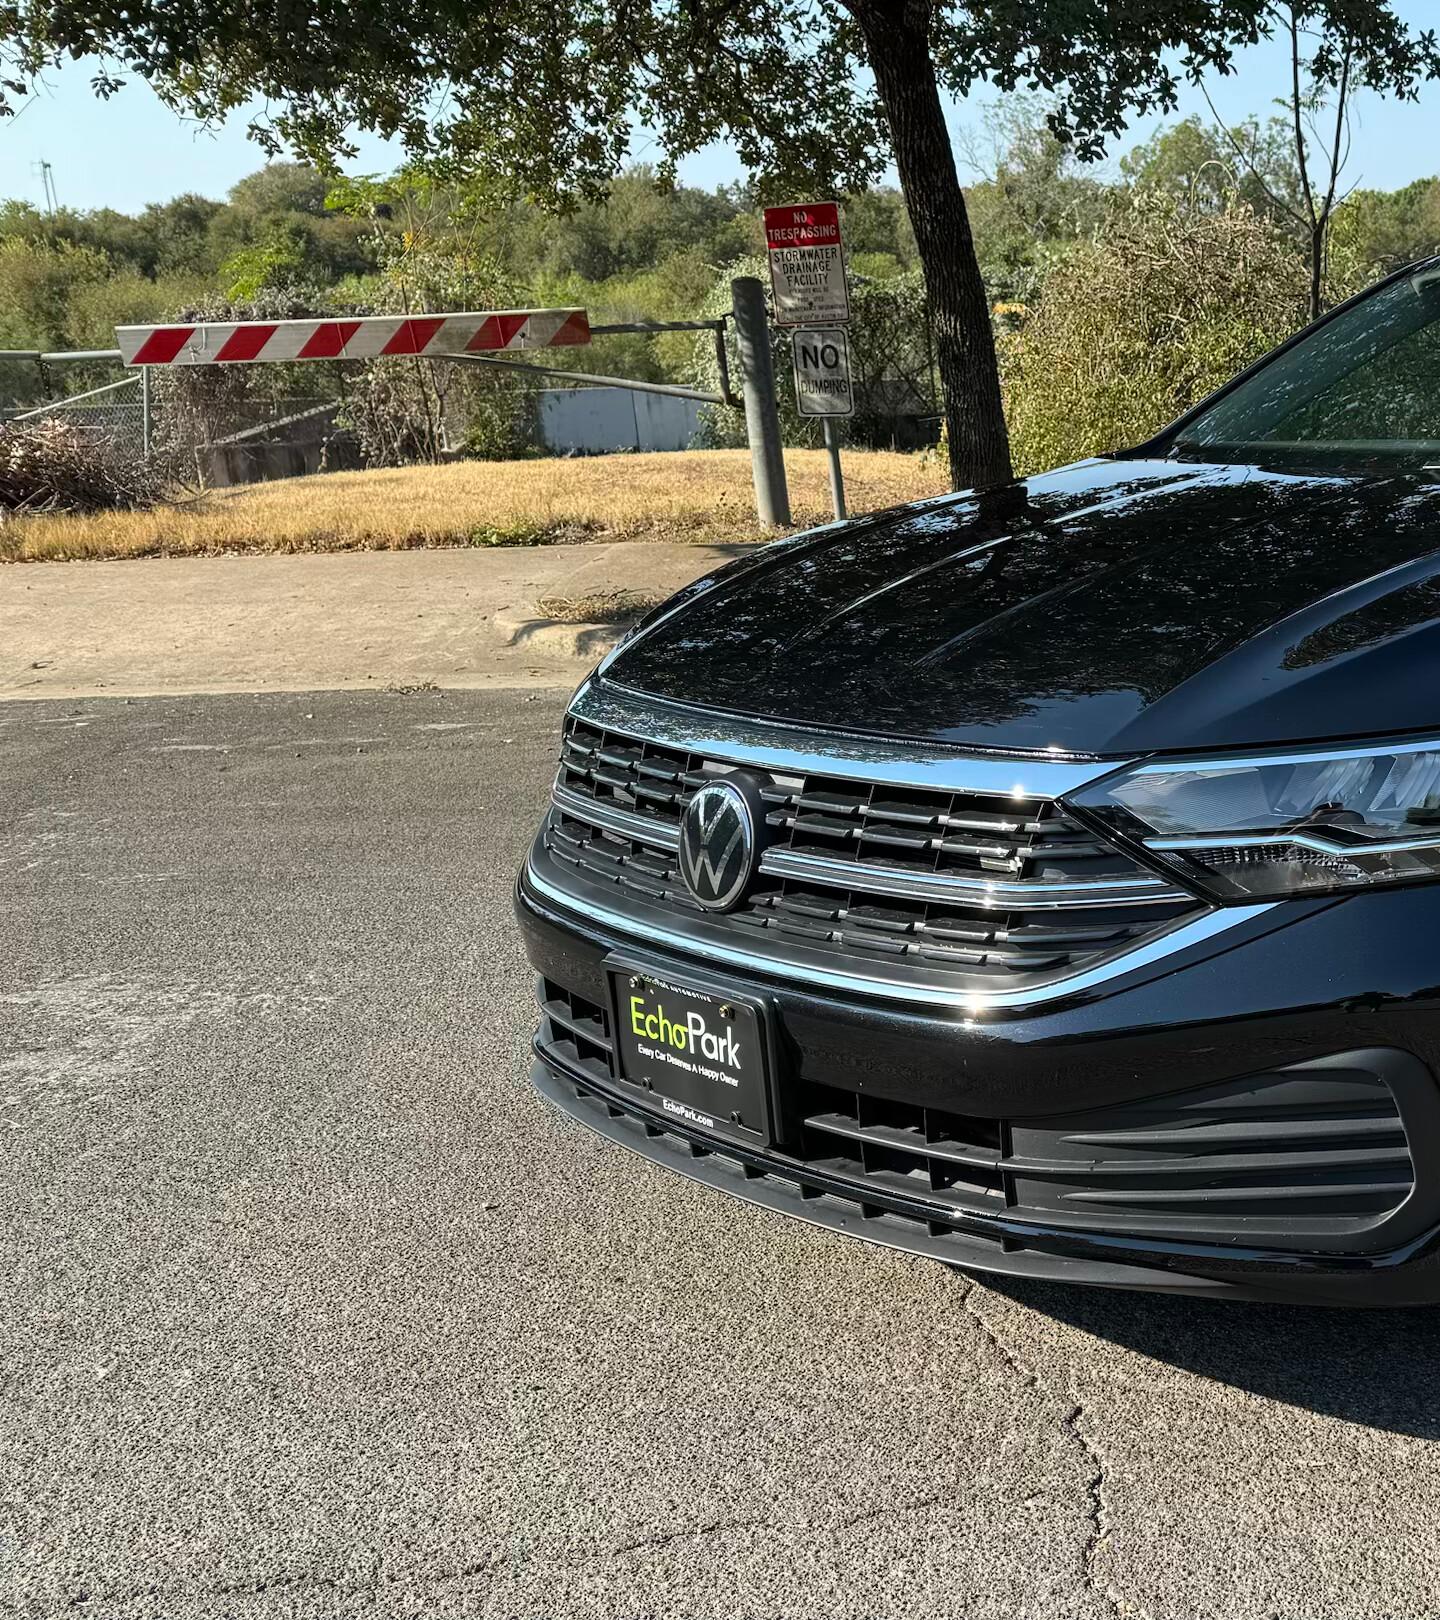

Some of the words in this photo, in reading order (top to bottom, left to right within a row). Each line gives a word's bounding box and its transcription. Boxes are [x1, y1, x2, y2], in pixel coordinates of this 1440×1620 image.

[793, 211, 808, 224] NO
[768, 224, 837, 241] TRESPASSING
[774, 247, 838, 263] STORMWATER
[782, 260, 832, 275] DRAINAGE
[786, 273, 829, 287] FACILITY
[801, 344, 840, 369] NO
[801, 379, 848, 394] DUMPING
[682, 783, 752, 909] VW
[630, 995, 742, 1070] EchoPark
[637, 1043, 655, 1060] Every
[655, 1049, 667, 1061] Car
[667, 1053, 692, 1072] Deserves
[692, 1063, 698, 1074] A
[698, 1065, 720, 1082] Happy
[720, 1071, 739, 1088] Owner
[662, 1098, 714, 1129] EchoPark.com
